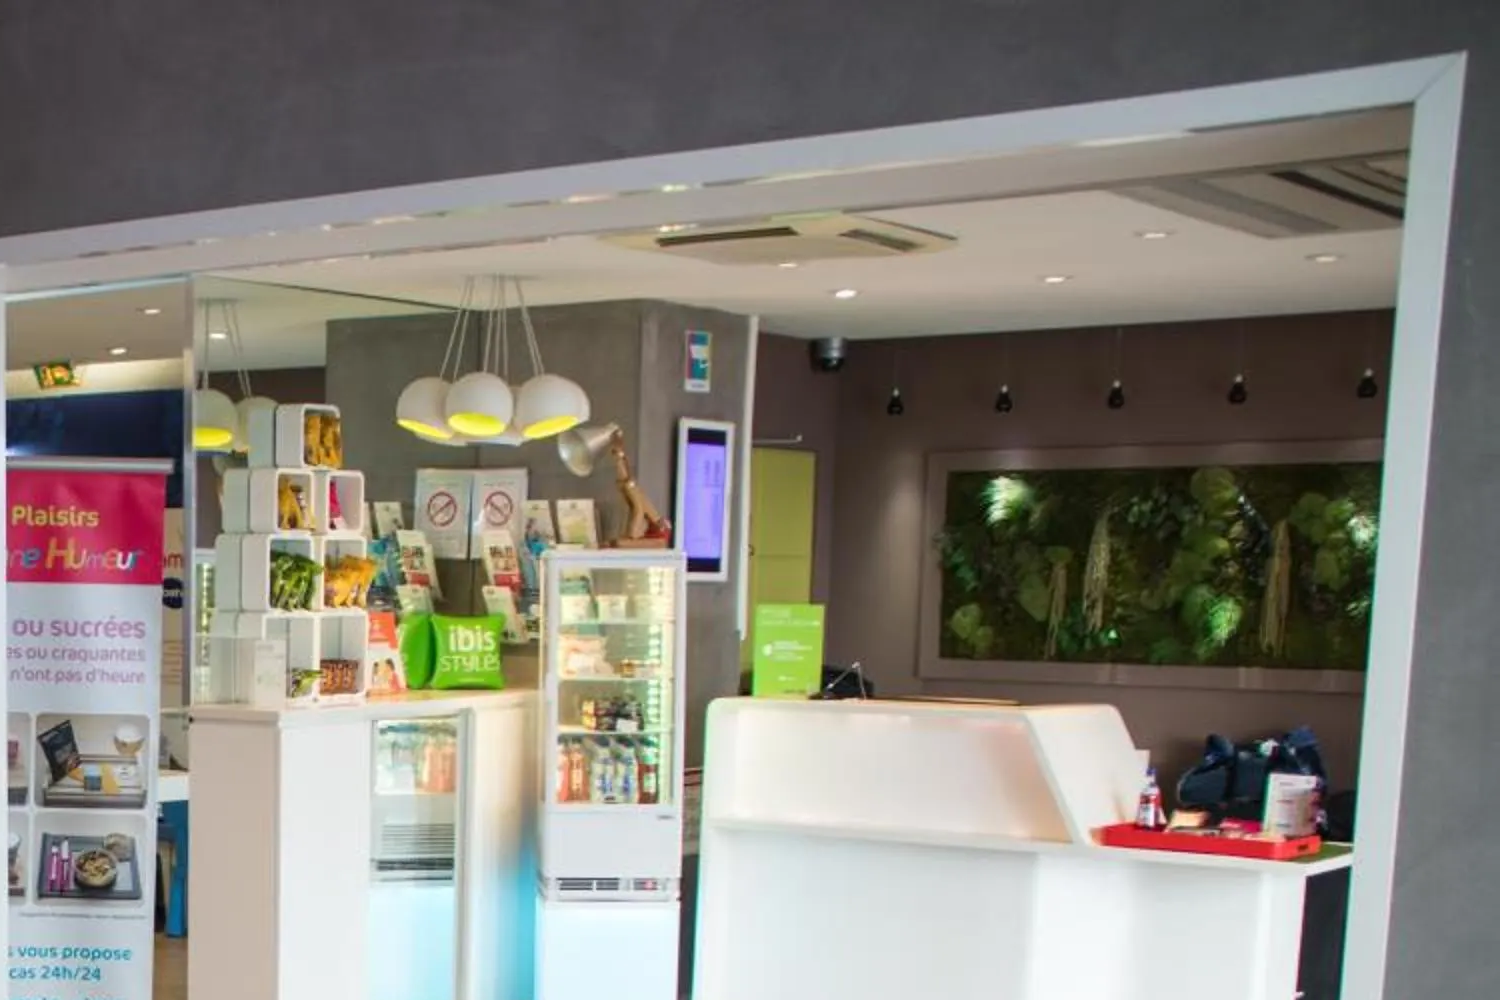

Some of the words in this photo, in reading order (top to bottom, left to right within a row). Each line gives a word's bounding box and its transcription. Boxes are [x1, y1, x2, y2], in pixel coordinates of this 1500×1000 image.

[11, 504, 100, 527] Plaisirs
[12, 619, 43, 637] ou
[51, 614, 146, 639] sucrées
[449, 625, 497, 653] ibis
[26, 646, 48, 660] ou
[51, 646, 146, 664] craquantes
[10, 665, 51, 682] n'ont
[55, 669, 82, 685] pas
[86, 666, 145, 684] d'heure
[17, 945, 57, 958] vous
[61, 945, 133, 962] propose
[8, 967, 36, 980] cas
[40, 965, 102, 981] 24h/24
